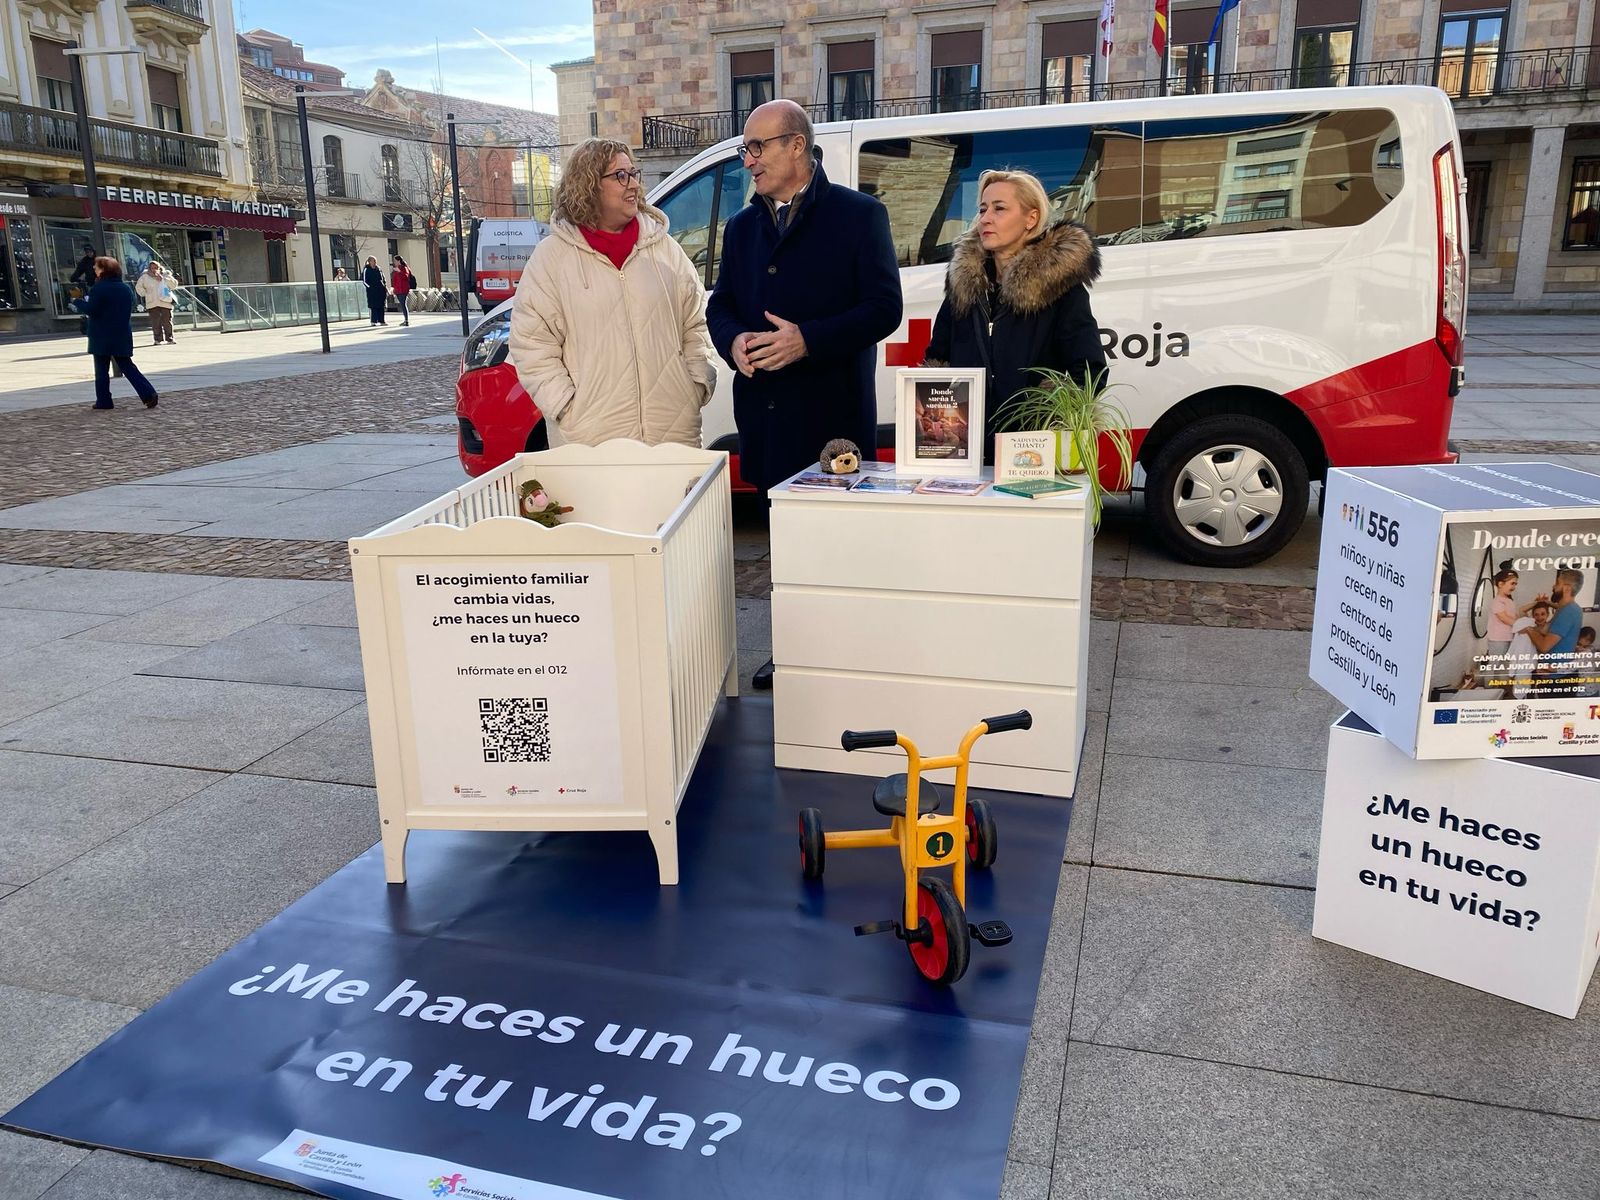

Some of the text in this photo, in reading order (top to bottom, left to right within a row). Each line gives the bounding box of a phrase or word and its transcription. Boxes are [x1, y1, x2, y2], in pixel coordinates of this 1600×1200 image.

[232, 200, 289, 218] MARDEM
[1097, 321, 1190, 367] Roja
[1367, 510, 1400, 547] 556
[1472, 528, 1600, 549] Donde cre
[1340, 543, 1405, 588] niños y niñas
[1513, 555, 1596, 571] crecen
[416, 572, 589, 588] El acogimiento familiar
[454, 592, 555, 606] cambia vidas,
[1344, 575, 1394, 612] crecen en
[432, 612, 580, 627] ¿me haces un hueco
[1340, 601, 1393, 642] centros de
[470, 632, 548, 646] en la tuya?
[1330, 622, 1398, 677] protección en
[1473, 653, 1516, 662] CAMPAÑA
[1532, 651, 1592, 660] ACOGIMIENTO
[457, 666, 568, 676] Infórmate en el 012
[1537, 662, 1549, 670] DE
[1550, 661, 1592, 669] CASTILLA
[1328, 646, 1396, 706] Castilla y León
[1366, 794, 1542, 851] ¿Me haces
[936, 835, 946, 855] 1
[1371, 833, 1528, 888] un hueco
[1358, 868, 1542, 932] en tu vida?
[227, 962, 962, 1111] ¿Me haces un hueco
[314, 1050, 743, 1157] en tu vida?
[314, 1148, 337, 1158] Junta
[342, 1160, 362, 1168] León
[460, 1186, 491, 1198] Servicios
